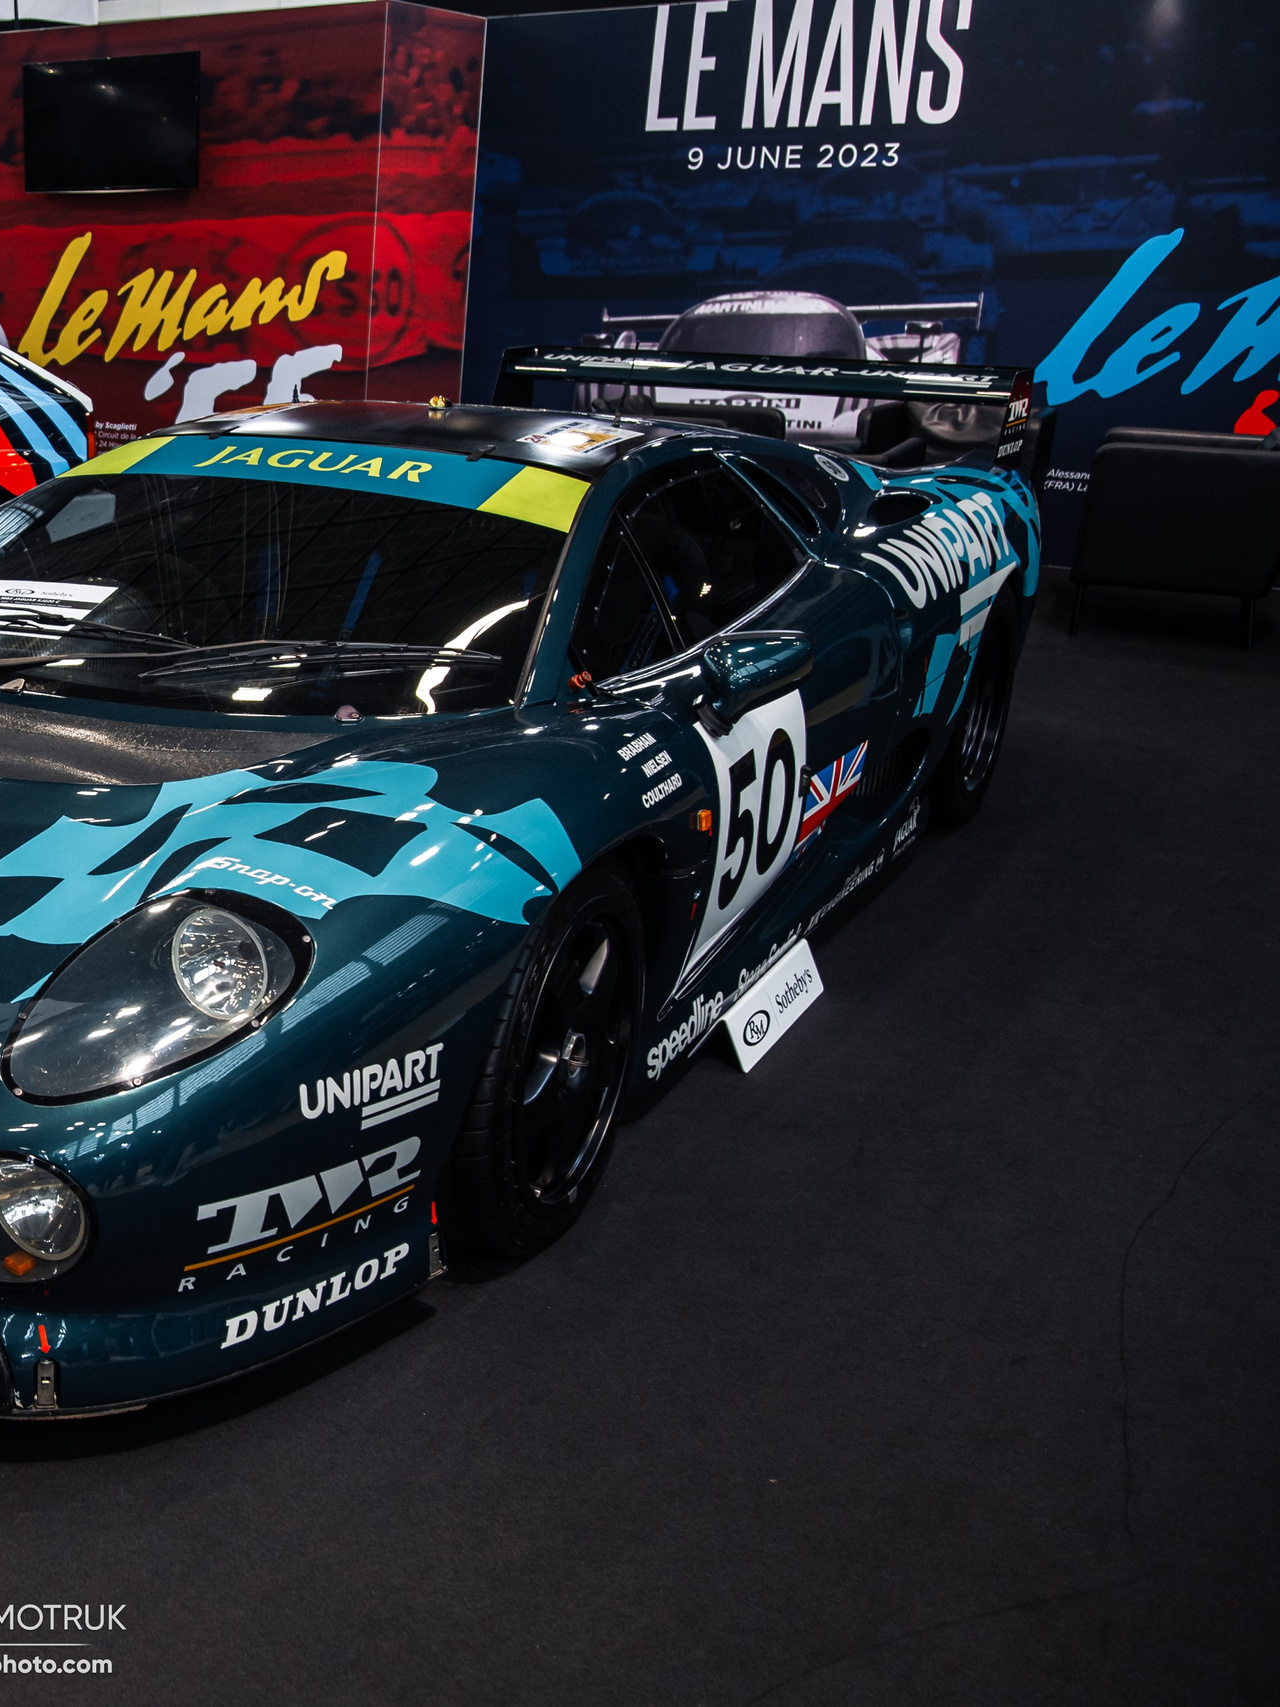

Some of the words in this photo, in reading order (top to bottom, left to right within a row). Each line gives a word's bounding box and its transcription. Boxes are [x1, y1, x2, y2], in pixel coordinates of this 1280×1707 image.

[645, 0, 727, 132] LE
[741, 0, 972, 129] MANS
[687, 147, 703, 170] 9
[717, 145, 804, 170] JUNE
[818, 143, 901, 168] 2023
[670, 359, 840, 378] JAGUAR
[95, 421, 105, 430] by
[98, 431, 119, 440] Circuit
[120, 432, 129, 440] de
[193, 445, 433, 483] JAGUAR
[997, 439, 1023, 459] DUNLOP
[1044, 480, 1075, 492] (FRA)
[1046, 468, 1090, 480] Alessan
[861, 491, 1010, 609] UNIPART
[617, 732, 657, 762] BRABHAM
[640, 749, 673, 778] NIELSEN
[641, 773, 683, 809] COULTHARD
[719, 727, 797, 911] 50
[206, 857, 338, 910] Snap-on
[774, 968, 814, 1015] Sotheby's
[646, 991, 724, 1082] speedline
[299, 1043, 444, 1119] UNIPART
[197, 1136, 422, 1254] TWR
[177, 1196, 409, 1292] RACING
[220, 1243, 410, 1349] DUNLOP
